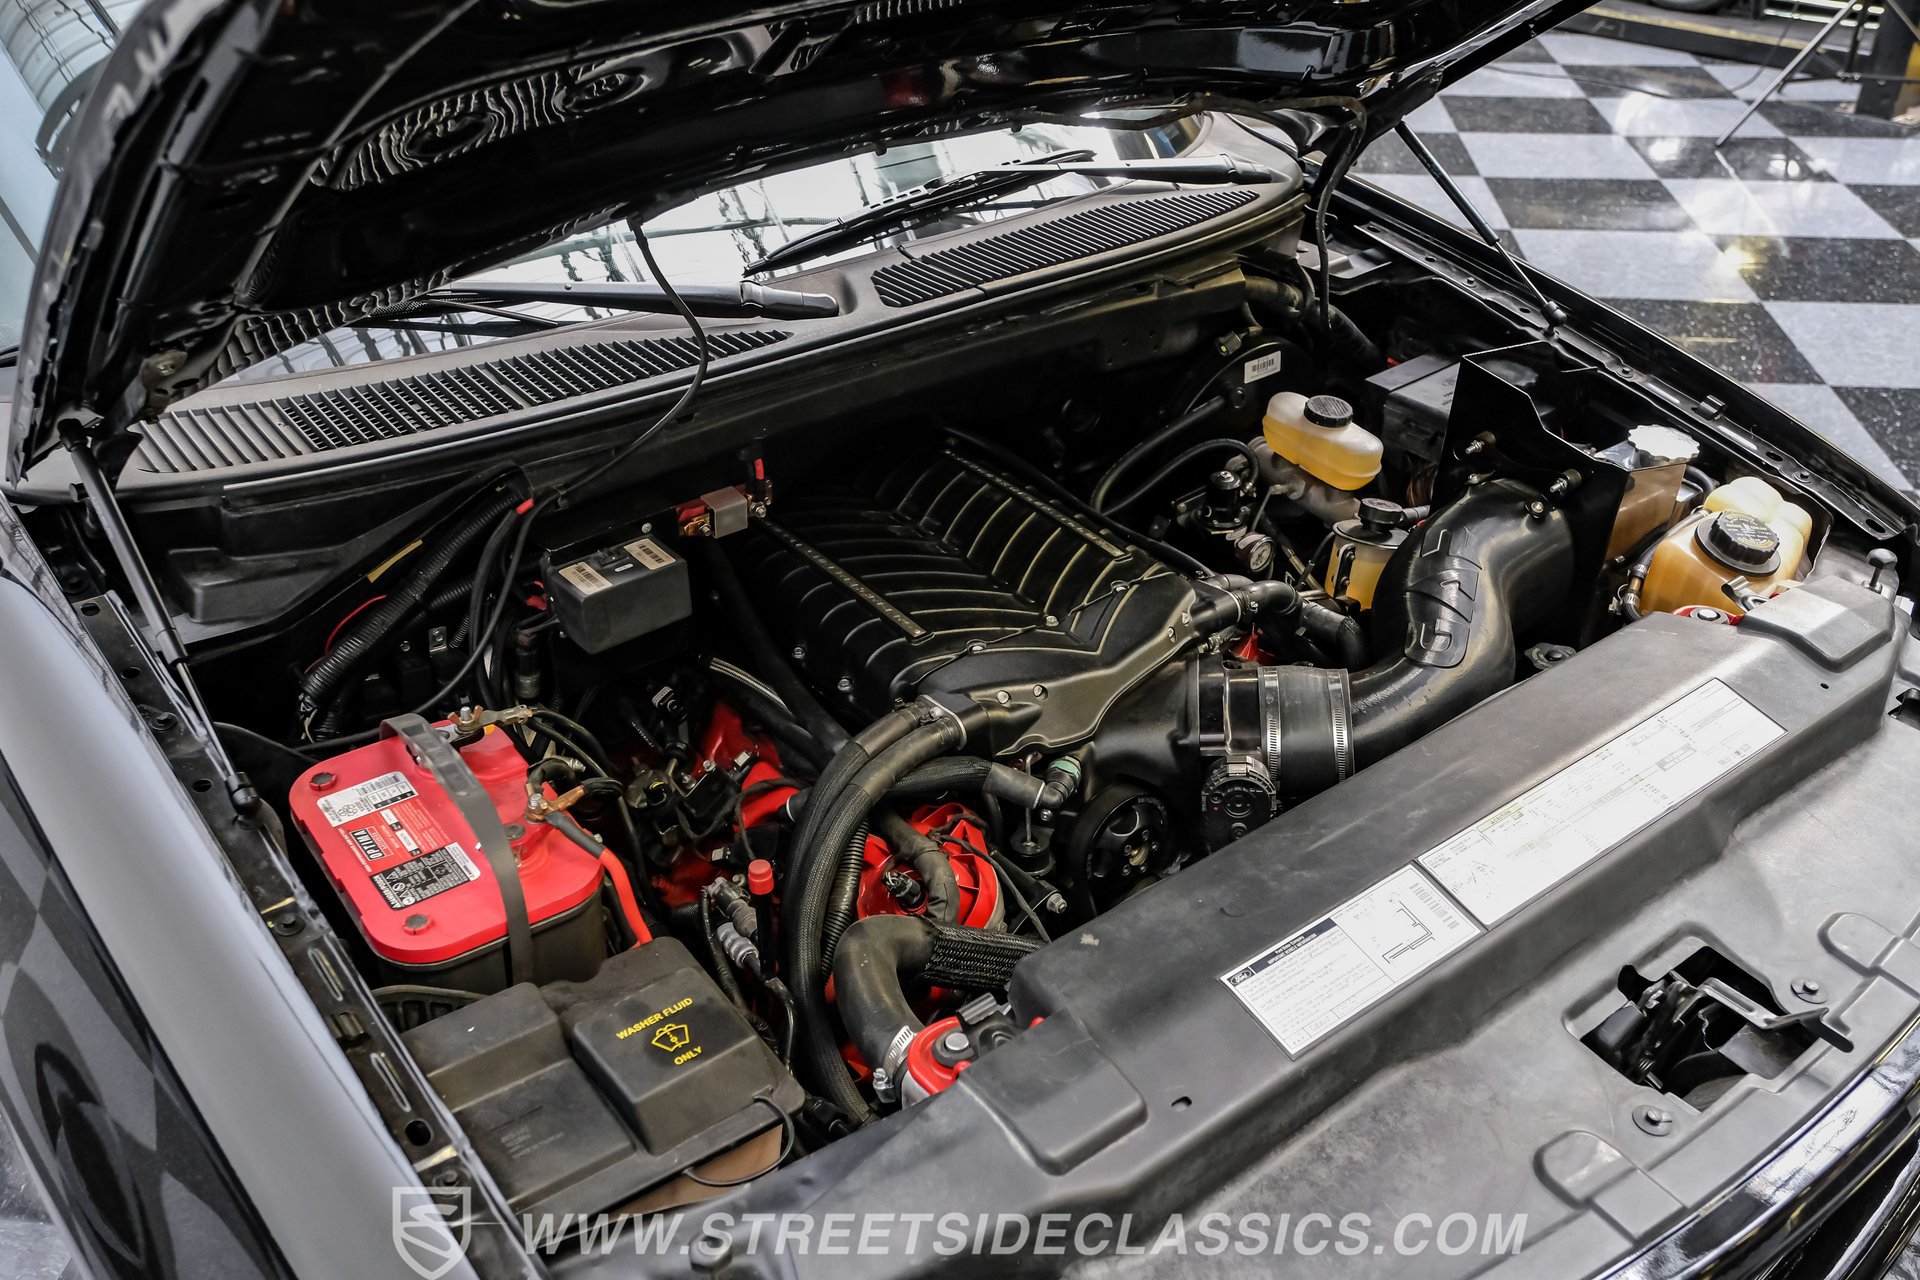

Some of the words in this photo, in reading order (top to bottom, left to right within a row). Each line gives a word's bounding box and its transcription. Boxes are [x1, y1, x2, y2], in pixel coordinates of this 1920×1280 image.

[353, 829, 384, 859] OPTIMA
[1235, 971, 1248, 984] Ford
[616, 1012, 664, 1040] WASHER
[663, 997, 694, 1017] FLUID
[674, 1045, 703, 1066] ONLY
